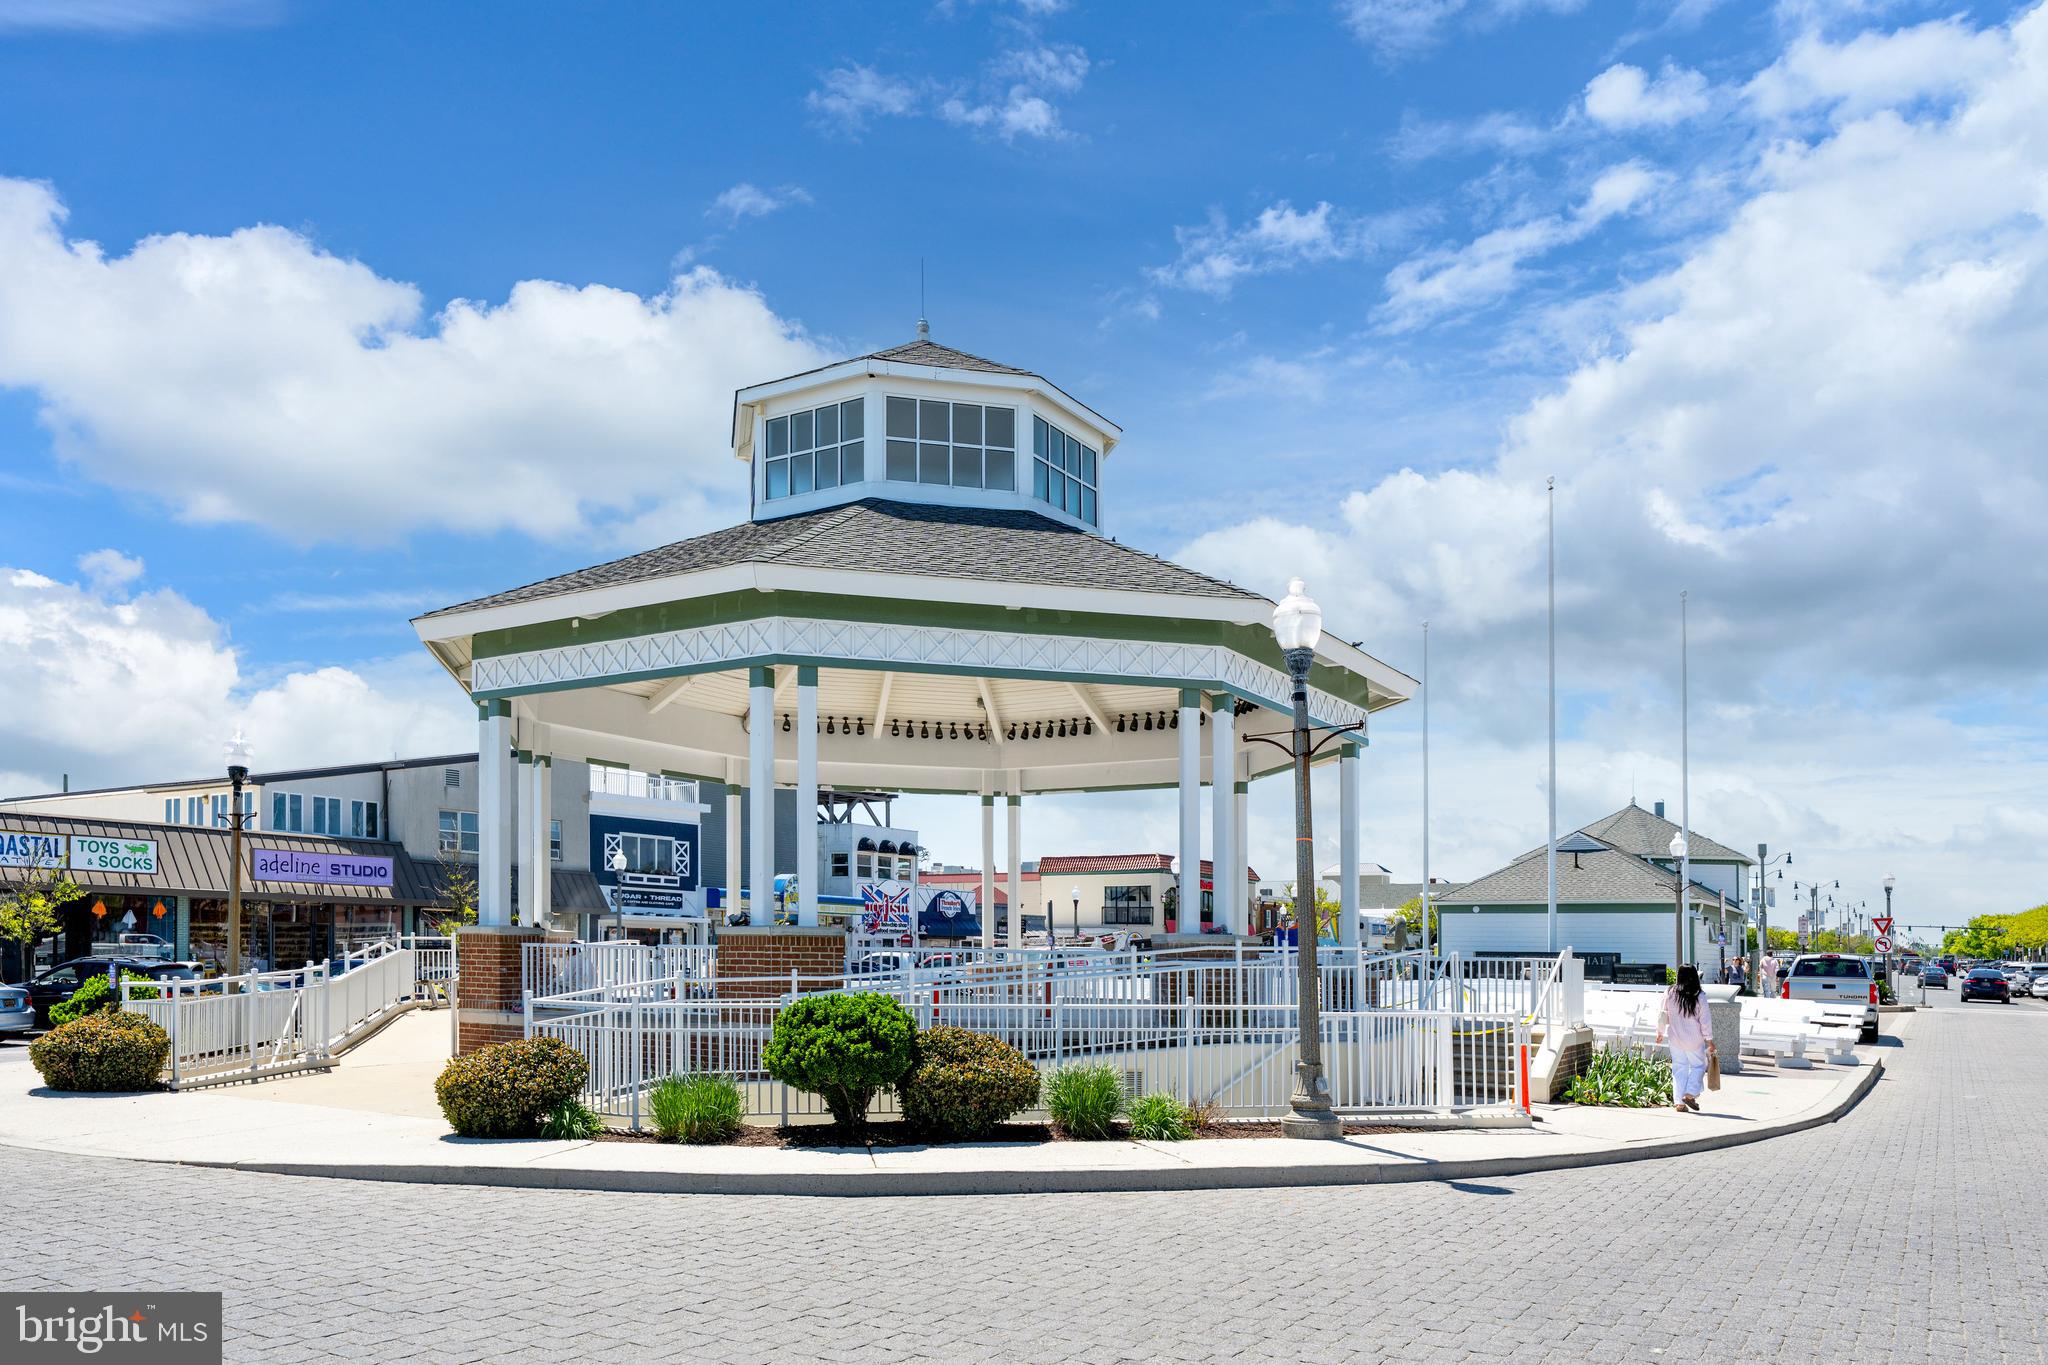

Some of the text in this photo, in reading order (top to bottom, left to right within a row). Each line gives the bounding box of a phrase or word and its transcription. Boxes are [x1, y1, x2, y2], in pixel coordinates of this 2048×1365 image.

[77, 839, 120, 854] TOYS
[87, 855, 153, 870] & SOCKS
[259, 853, 388, 878] adeline STUDIO
